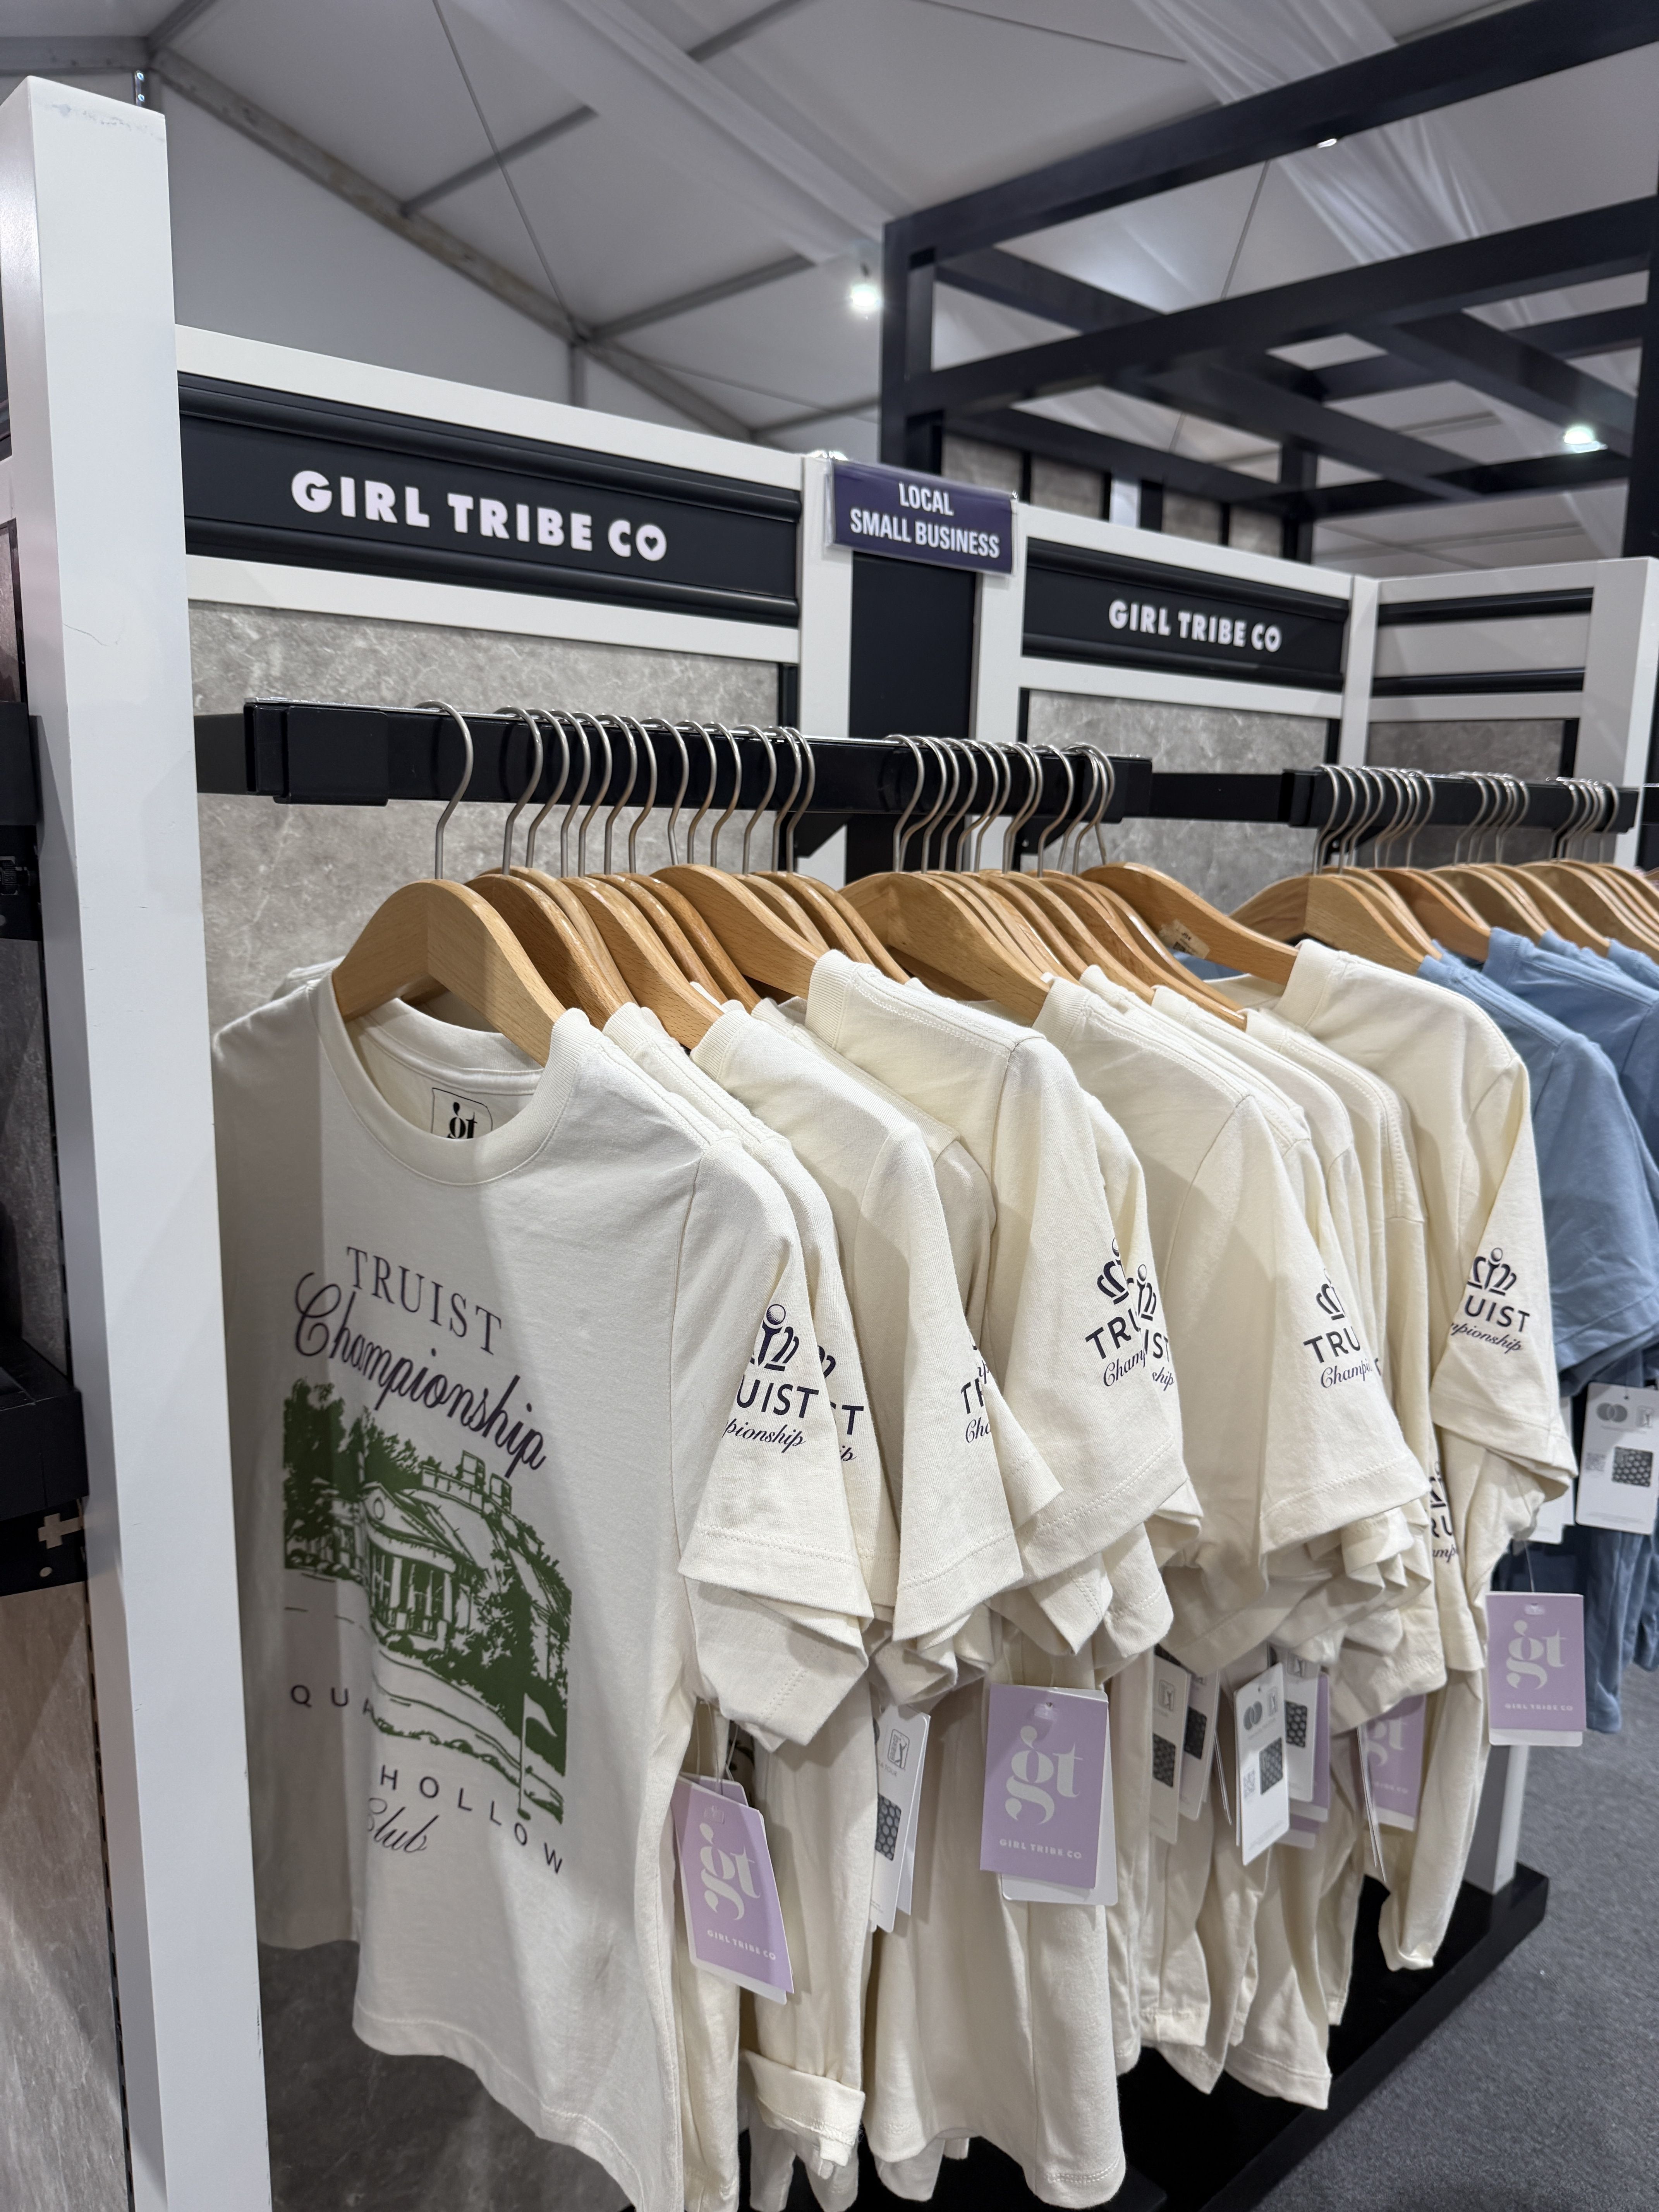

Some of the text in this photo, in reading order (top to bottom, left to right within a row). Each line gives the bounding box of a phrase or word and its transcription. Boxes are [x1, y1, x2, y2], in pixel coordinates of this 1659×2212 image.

[291, 470, 667, 561] GIRL TRIBE CO
[898, 482, 954, 516] LOCAL
[850, 507, 1000, 558] SMALL BUSINESS
[1109, 599, 1282, 652] GIRL TRIBE CO
[347, 1247, 501, 1355] TRUIST
[1465, 1295, 1530, 1332] UIST
[1303, 1326, 1360, 1363] TRU
[295, 1272, 546, 1479] Championship
[737, 1375, 819, 1418] UIST
[722, 1418, 807, 1453] pionship
[1506, 1620, 1567, 1690] gt
[1005, 1726, 1083, 1824] gt
[380, 1765, 562, 1874] HOLLOW
[699, 1823, 761, 1920] gt
[1000, 1839, 1082, 1859] GIRL TRIBE CO
[707, 1929, 776, 1960] GIRL TRIBE CO
